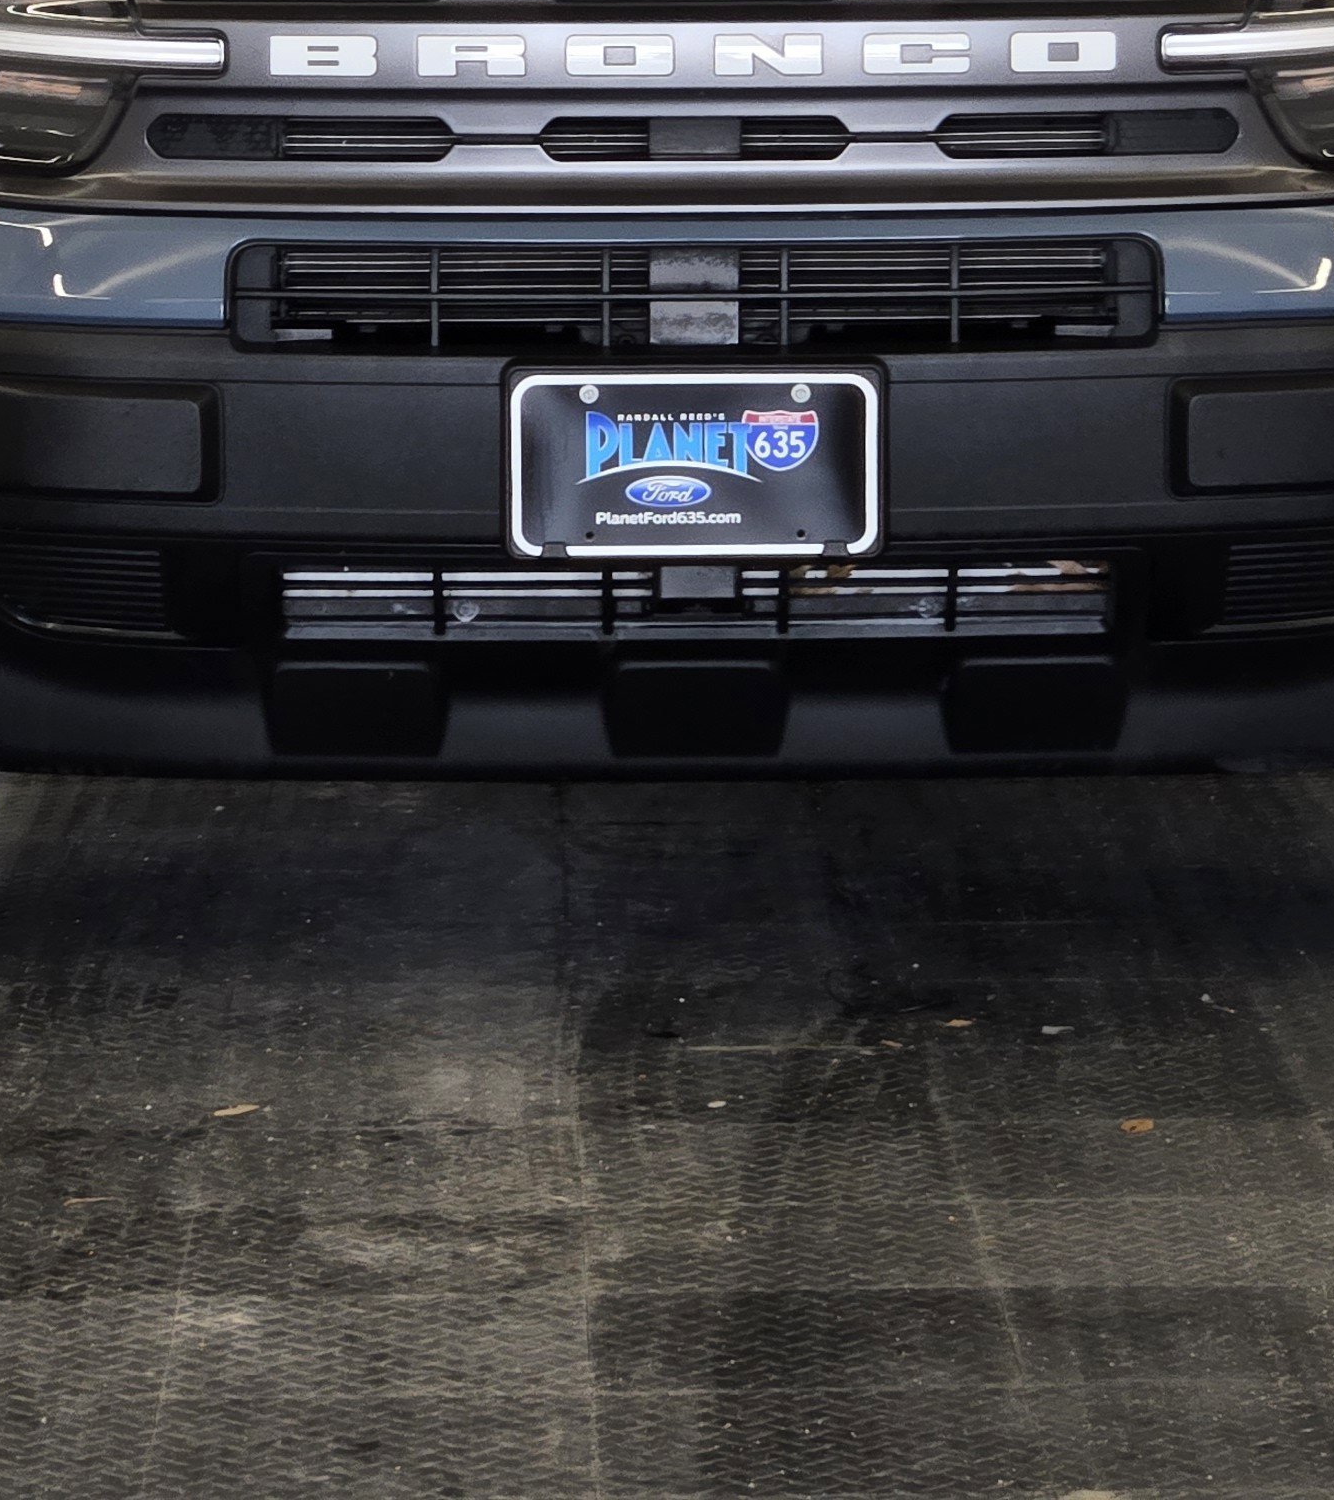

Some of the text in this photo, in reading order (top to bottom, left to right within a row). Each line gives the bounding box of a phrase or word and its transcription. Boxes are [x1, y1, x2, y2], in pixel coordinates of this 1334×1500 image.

[269, 31, 1117, 77] BRONCO
[585, 410, 753, 479] PLANET
[754, 430, 806, 459] 635
[642, 481, 694, 503] Ford
[595, 511, 742, 525] PlanetFord635.com
